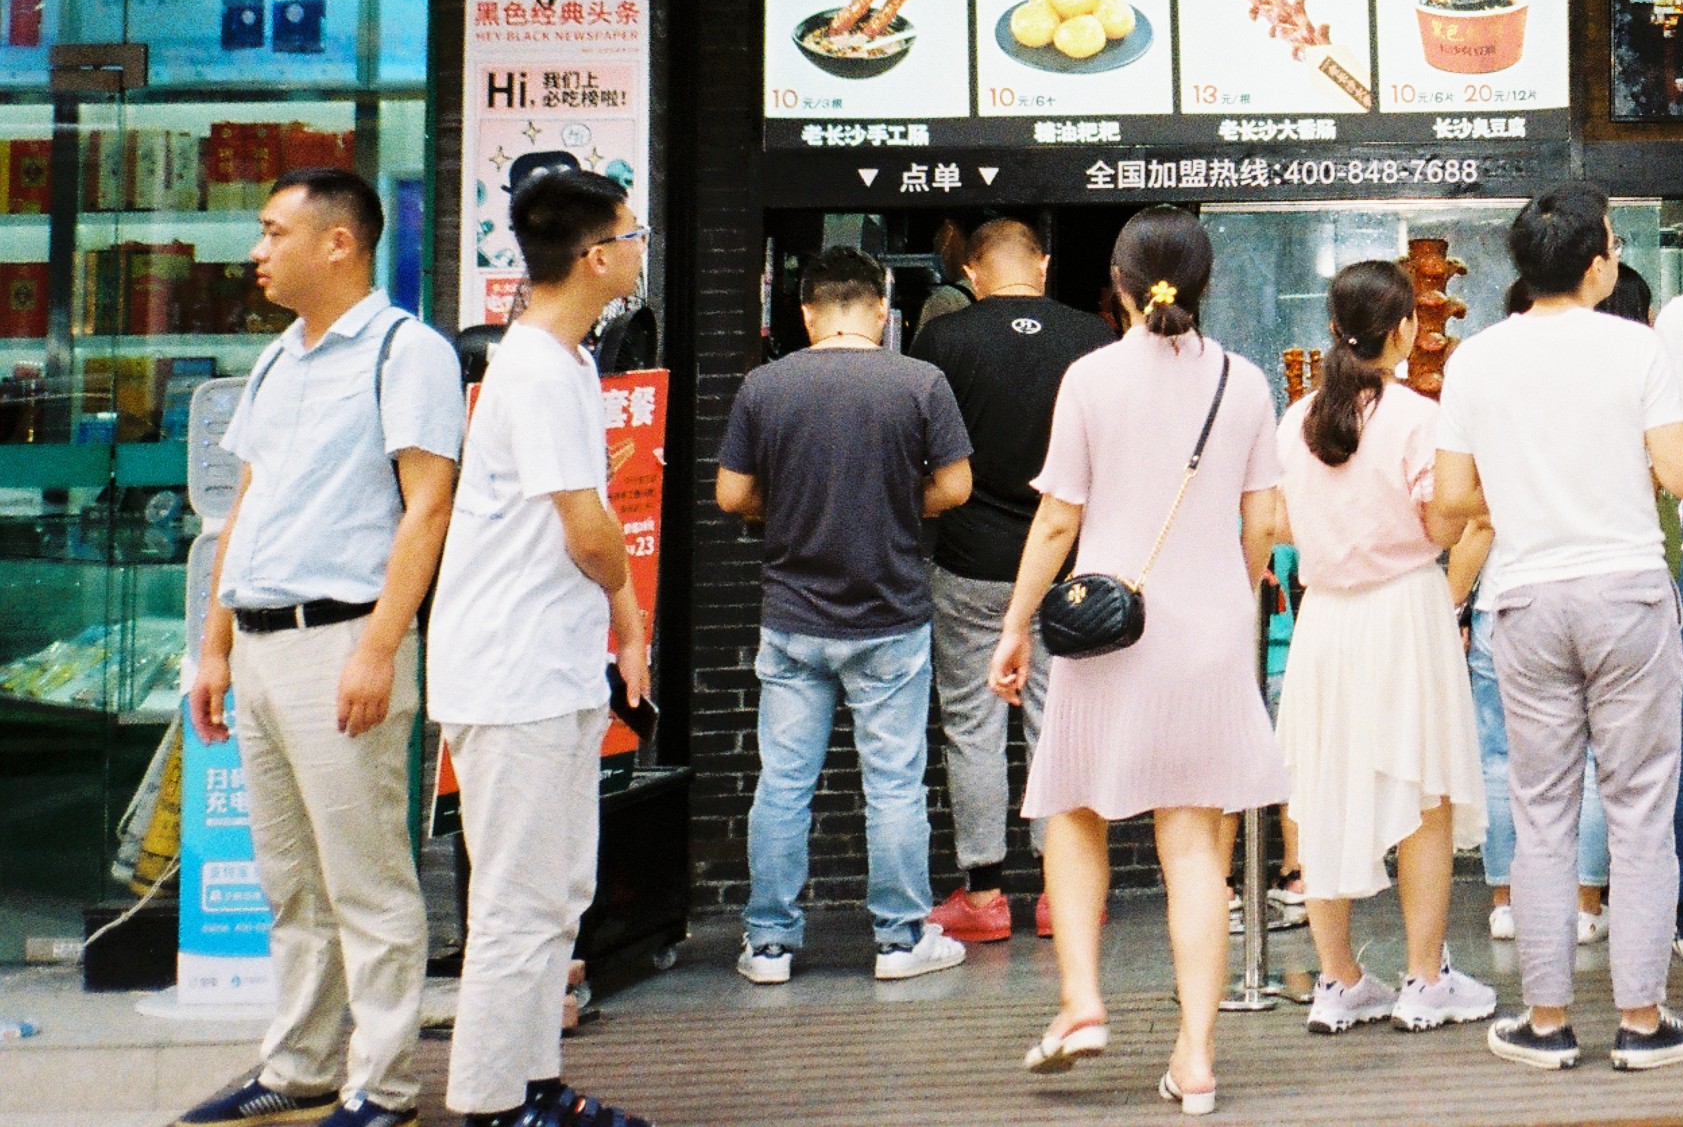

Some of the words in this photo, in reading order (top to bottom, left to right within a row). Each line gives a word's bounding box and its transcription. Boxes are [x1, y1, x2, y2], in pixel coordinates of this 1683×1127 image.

[507, 31, 549, 42] BLACK
[556, 31, 639, 42] NEWSPAPER
[801, 124, 930, 146] 老长沙手工肠
[1218, 118, 1337, 141] 老长沙大香肠
[1432, 117, 1526, 139] 长沙臭豆腐
[900, 163, 962, 192] 点单
